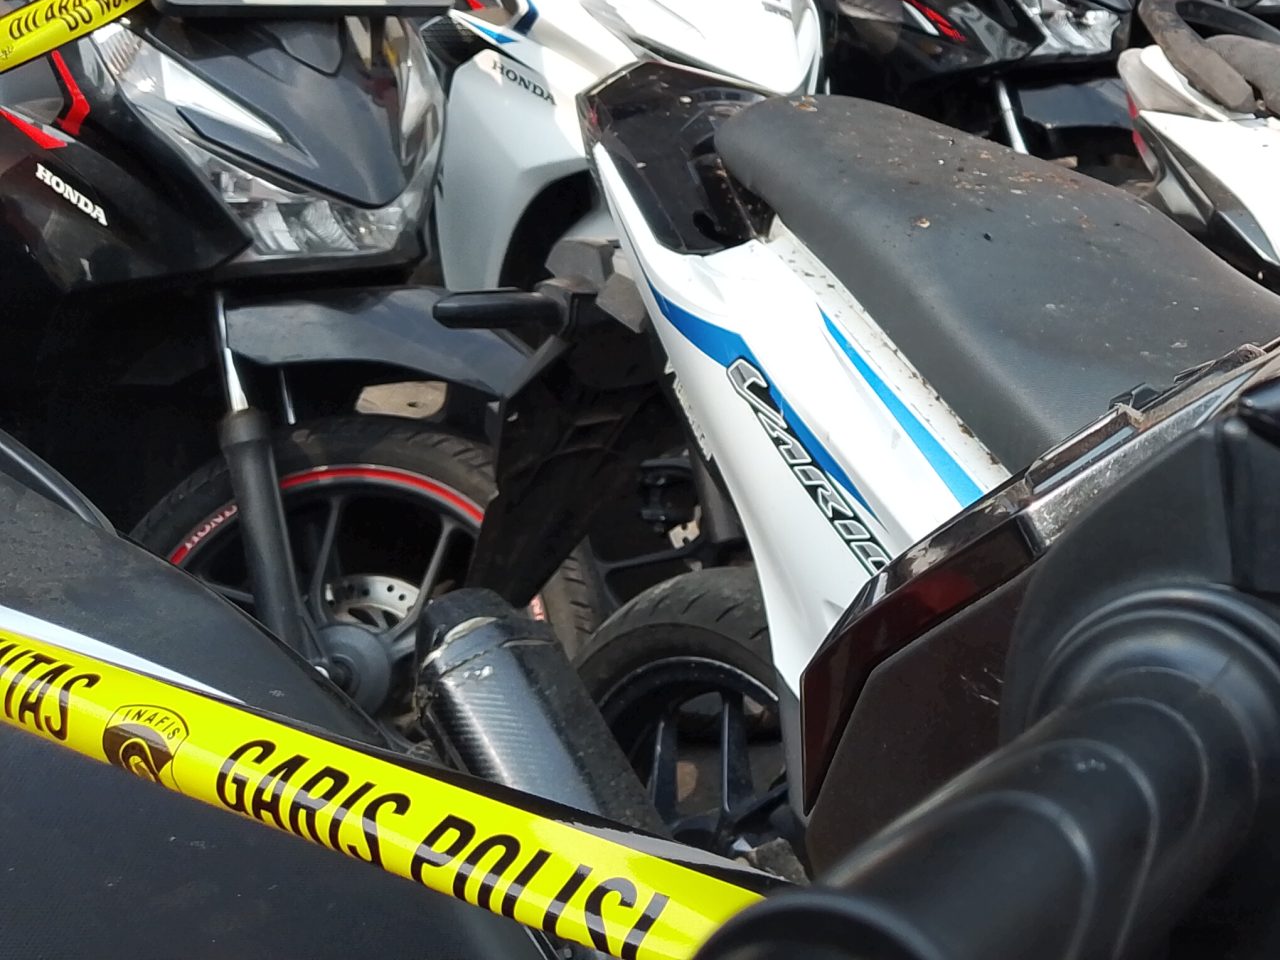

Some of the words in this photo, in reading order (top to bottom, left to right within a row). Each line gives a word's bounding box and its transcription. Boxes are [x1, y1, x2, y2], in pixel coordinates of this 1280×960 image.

[491, 59, 558, 107] HONDA
[35, 161, 109, 227] HONDA
[122, 708, 181, 741] INAFIS
[215, 739, 412, 870] GARIS
[410, 813, 671, 960] POLISI
